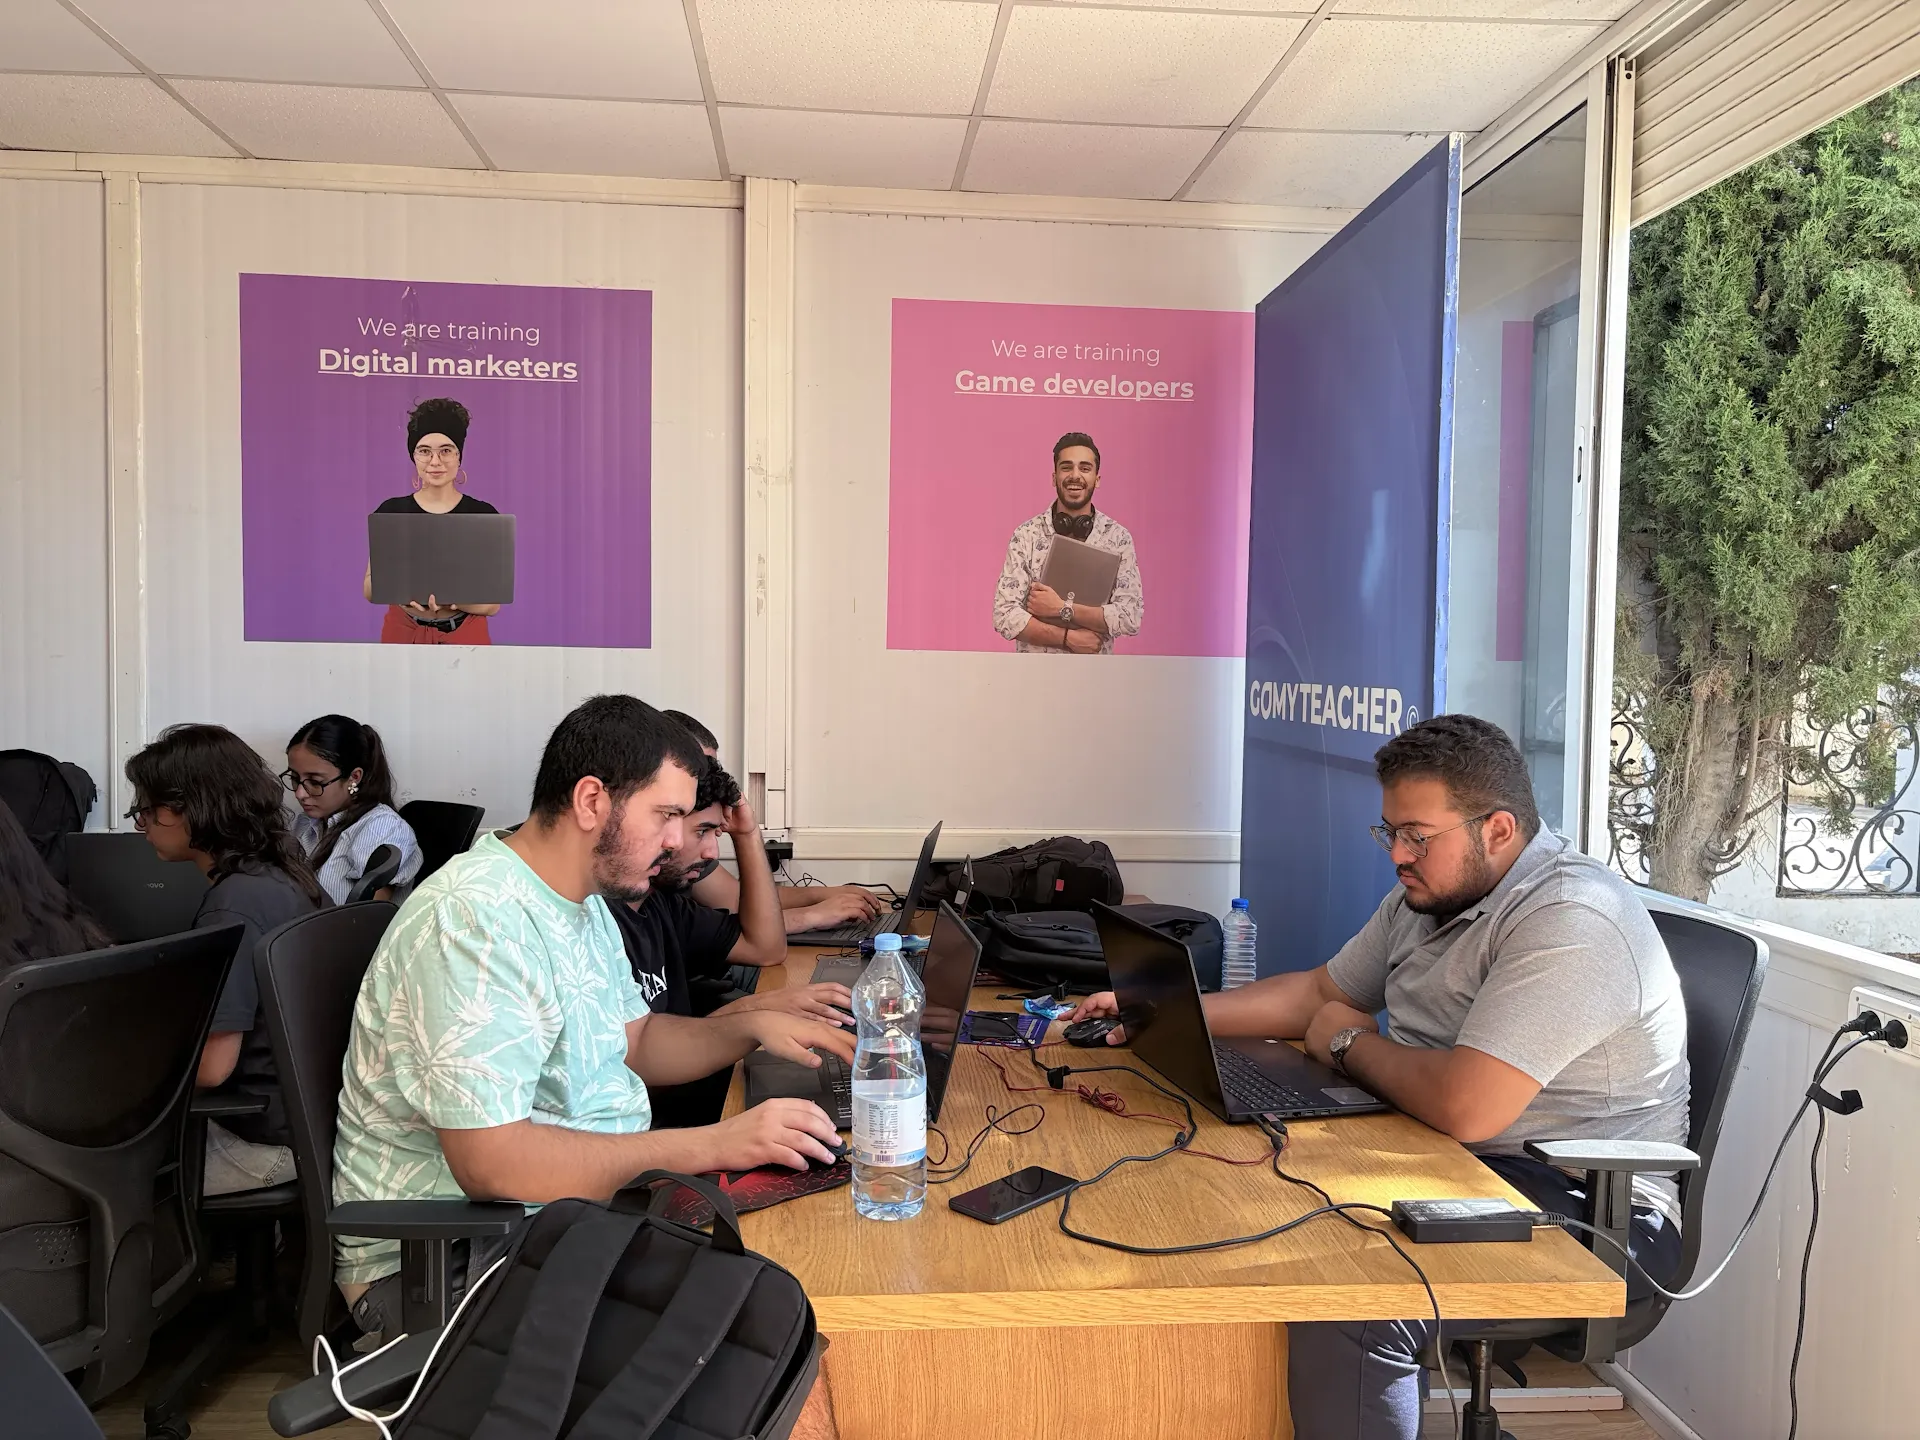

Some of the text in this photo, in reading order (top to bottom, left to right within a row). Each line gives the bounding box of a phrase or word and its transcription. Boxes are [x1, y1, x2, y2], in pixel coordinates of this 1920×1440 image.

[357, 317, 540, 346] We are training
[319, 347, 578, 380] Digital marketers
[991, 339, 1160, 367] We are training
[955, 369, 1194, 402] Game developers
[1250, 680, 1403, 736] GOMYTEACHER
